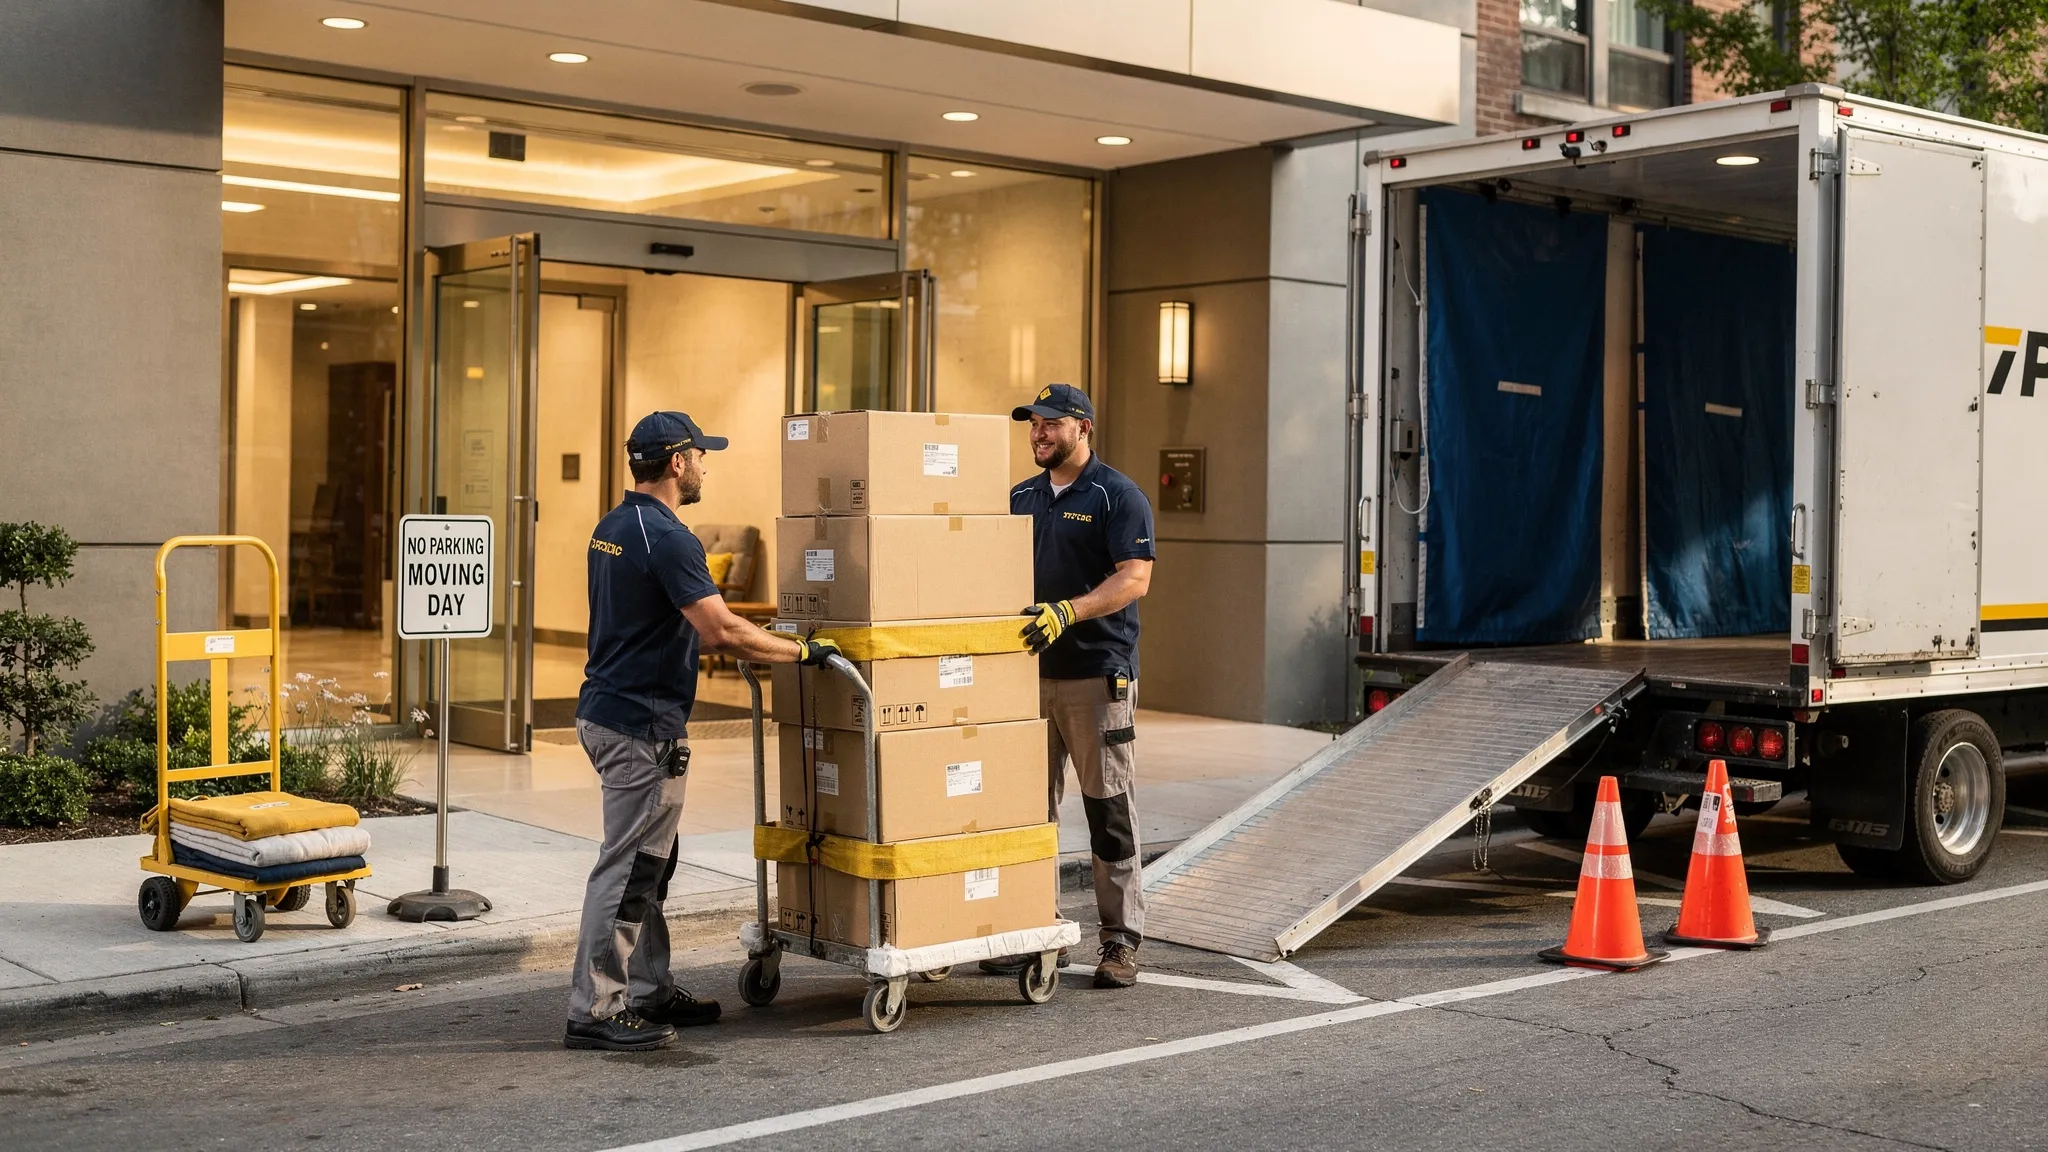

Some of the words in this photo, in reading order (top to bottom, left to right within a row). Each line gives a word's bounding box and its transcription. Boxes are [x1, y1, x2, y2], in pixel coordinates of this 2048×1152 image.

[408, 537, 426, 555] NO
[430, 537, 484, 555] PARKING
[408, 563, 484, 586] MOVING
[428, 593, 465, 616] DAY
